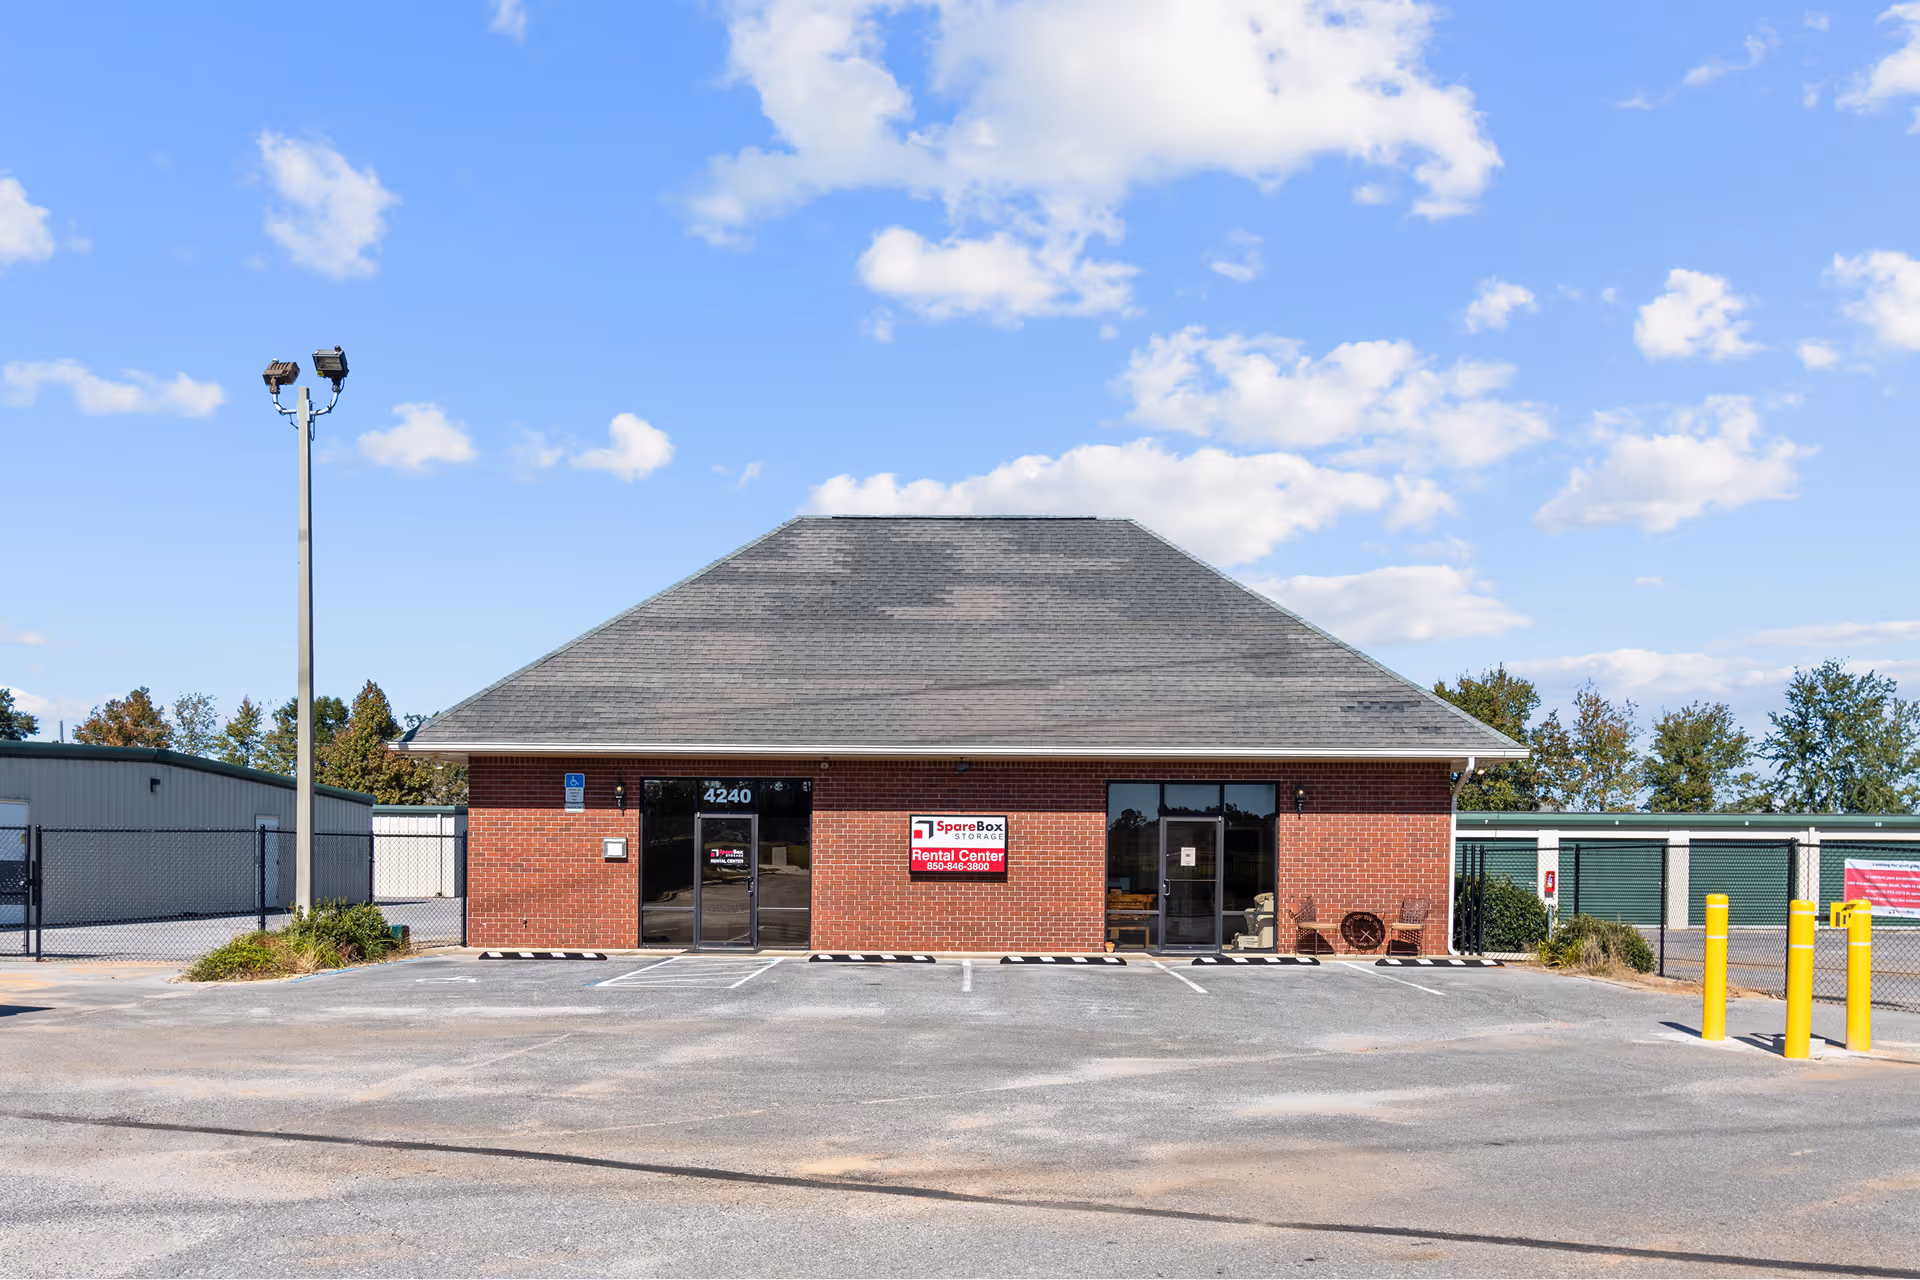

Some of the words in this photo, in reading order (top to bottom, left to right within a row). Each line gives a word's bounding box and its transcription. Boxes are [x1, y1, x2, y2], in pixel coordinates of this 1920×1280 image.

[703, 788, 752, 804] 4240
[936, 820, 1004, 835] SpareBox
[954, 833, 1004, 841] STORAGE
[912, 849, 955, 861] Rental
[958, 850, 1005, 862] Center
[926, 862, 990, 871] 850-846-3800
